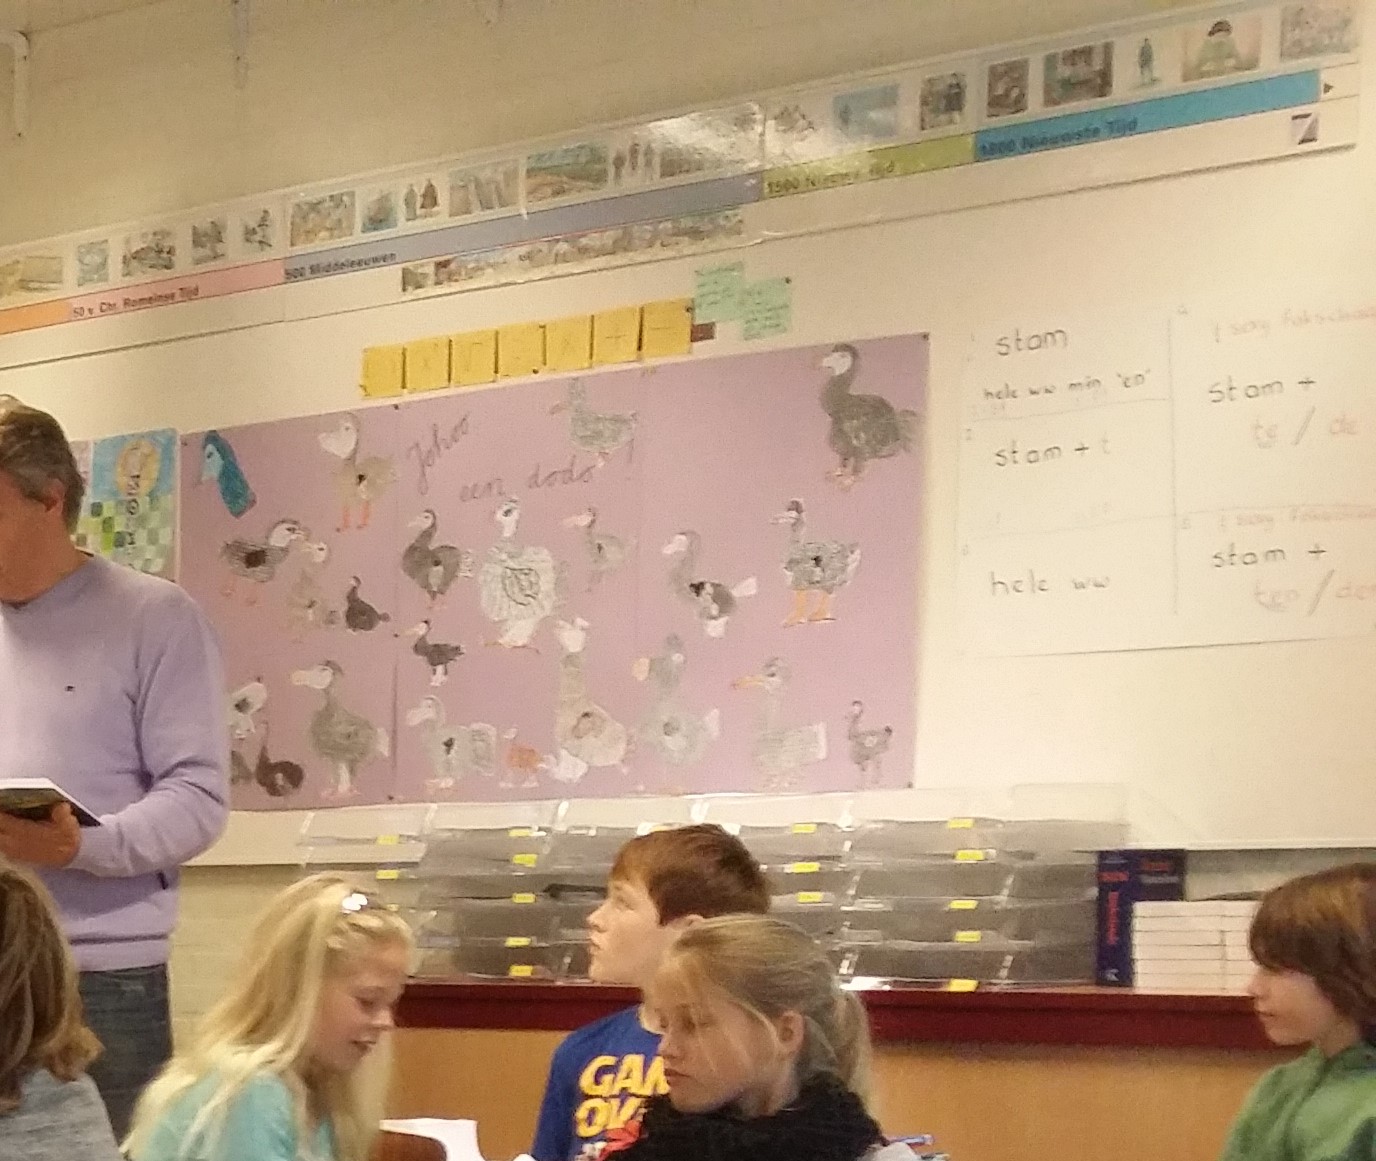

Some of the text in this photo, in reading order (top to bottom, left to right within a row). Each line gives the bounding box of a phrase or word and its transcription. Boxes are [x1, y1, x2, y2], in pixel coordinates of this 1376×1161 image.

[996, 328, 1068, 356] stam
[1208, 376, 1284, 404] stam
[995, 440, 1063, 467] stam
[1211, 541, 1287, 569] stam
[990, 569, 1049, 597] hele
[575, 1097, 645, 1138] OV
